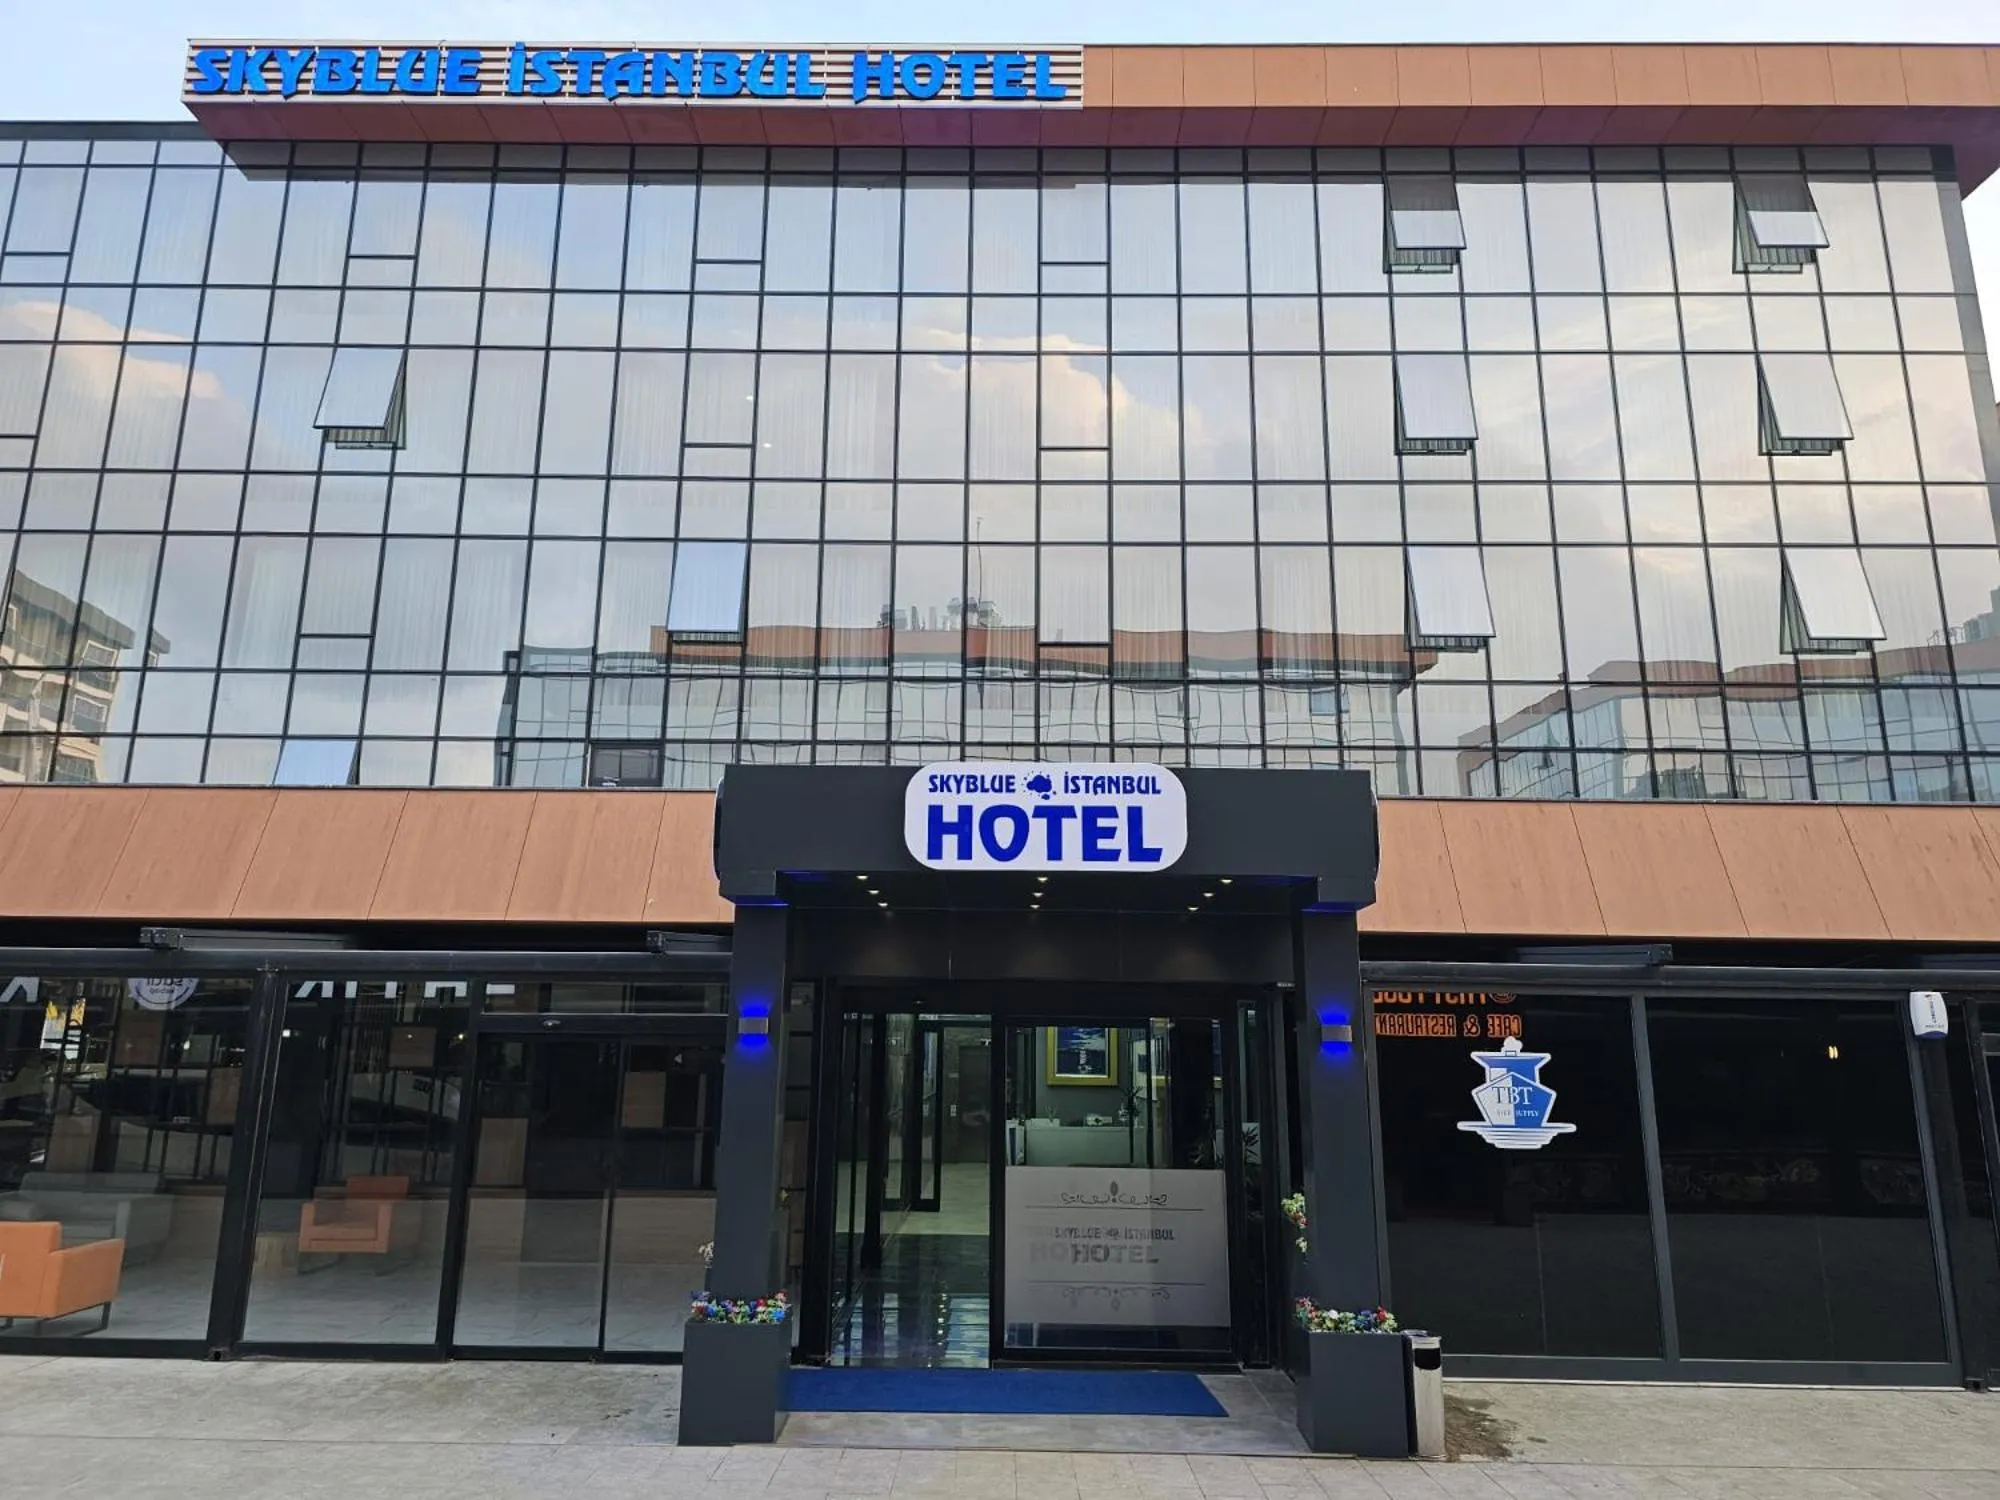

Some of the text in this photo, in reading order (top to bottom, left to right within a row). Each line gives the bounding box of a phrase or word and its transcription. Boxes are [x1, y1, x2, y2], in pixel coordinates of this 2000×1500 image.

[192, 41, 1067, 104] SKYBLUE İSTANBUL HOTEL
[928, 771, 1162, 796] SKYBLUE İSTANBUL
[927, 803, 1163, 862] HOTEL
[1491, 1086, 1533, 1105] TBT
